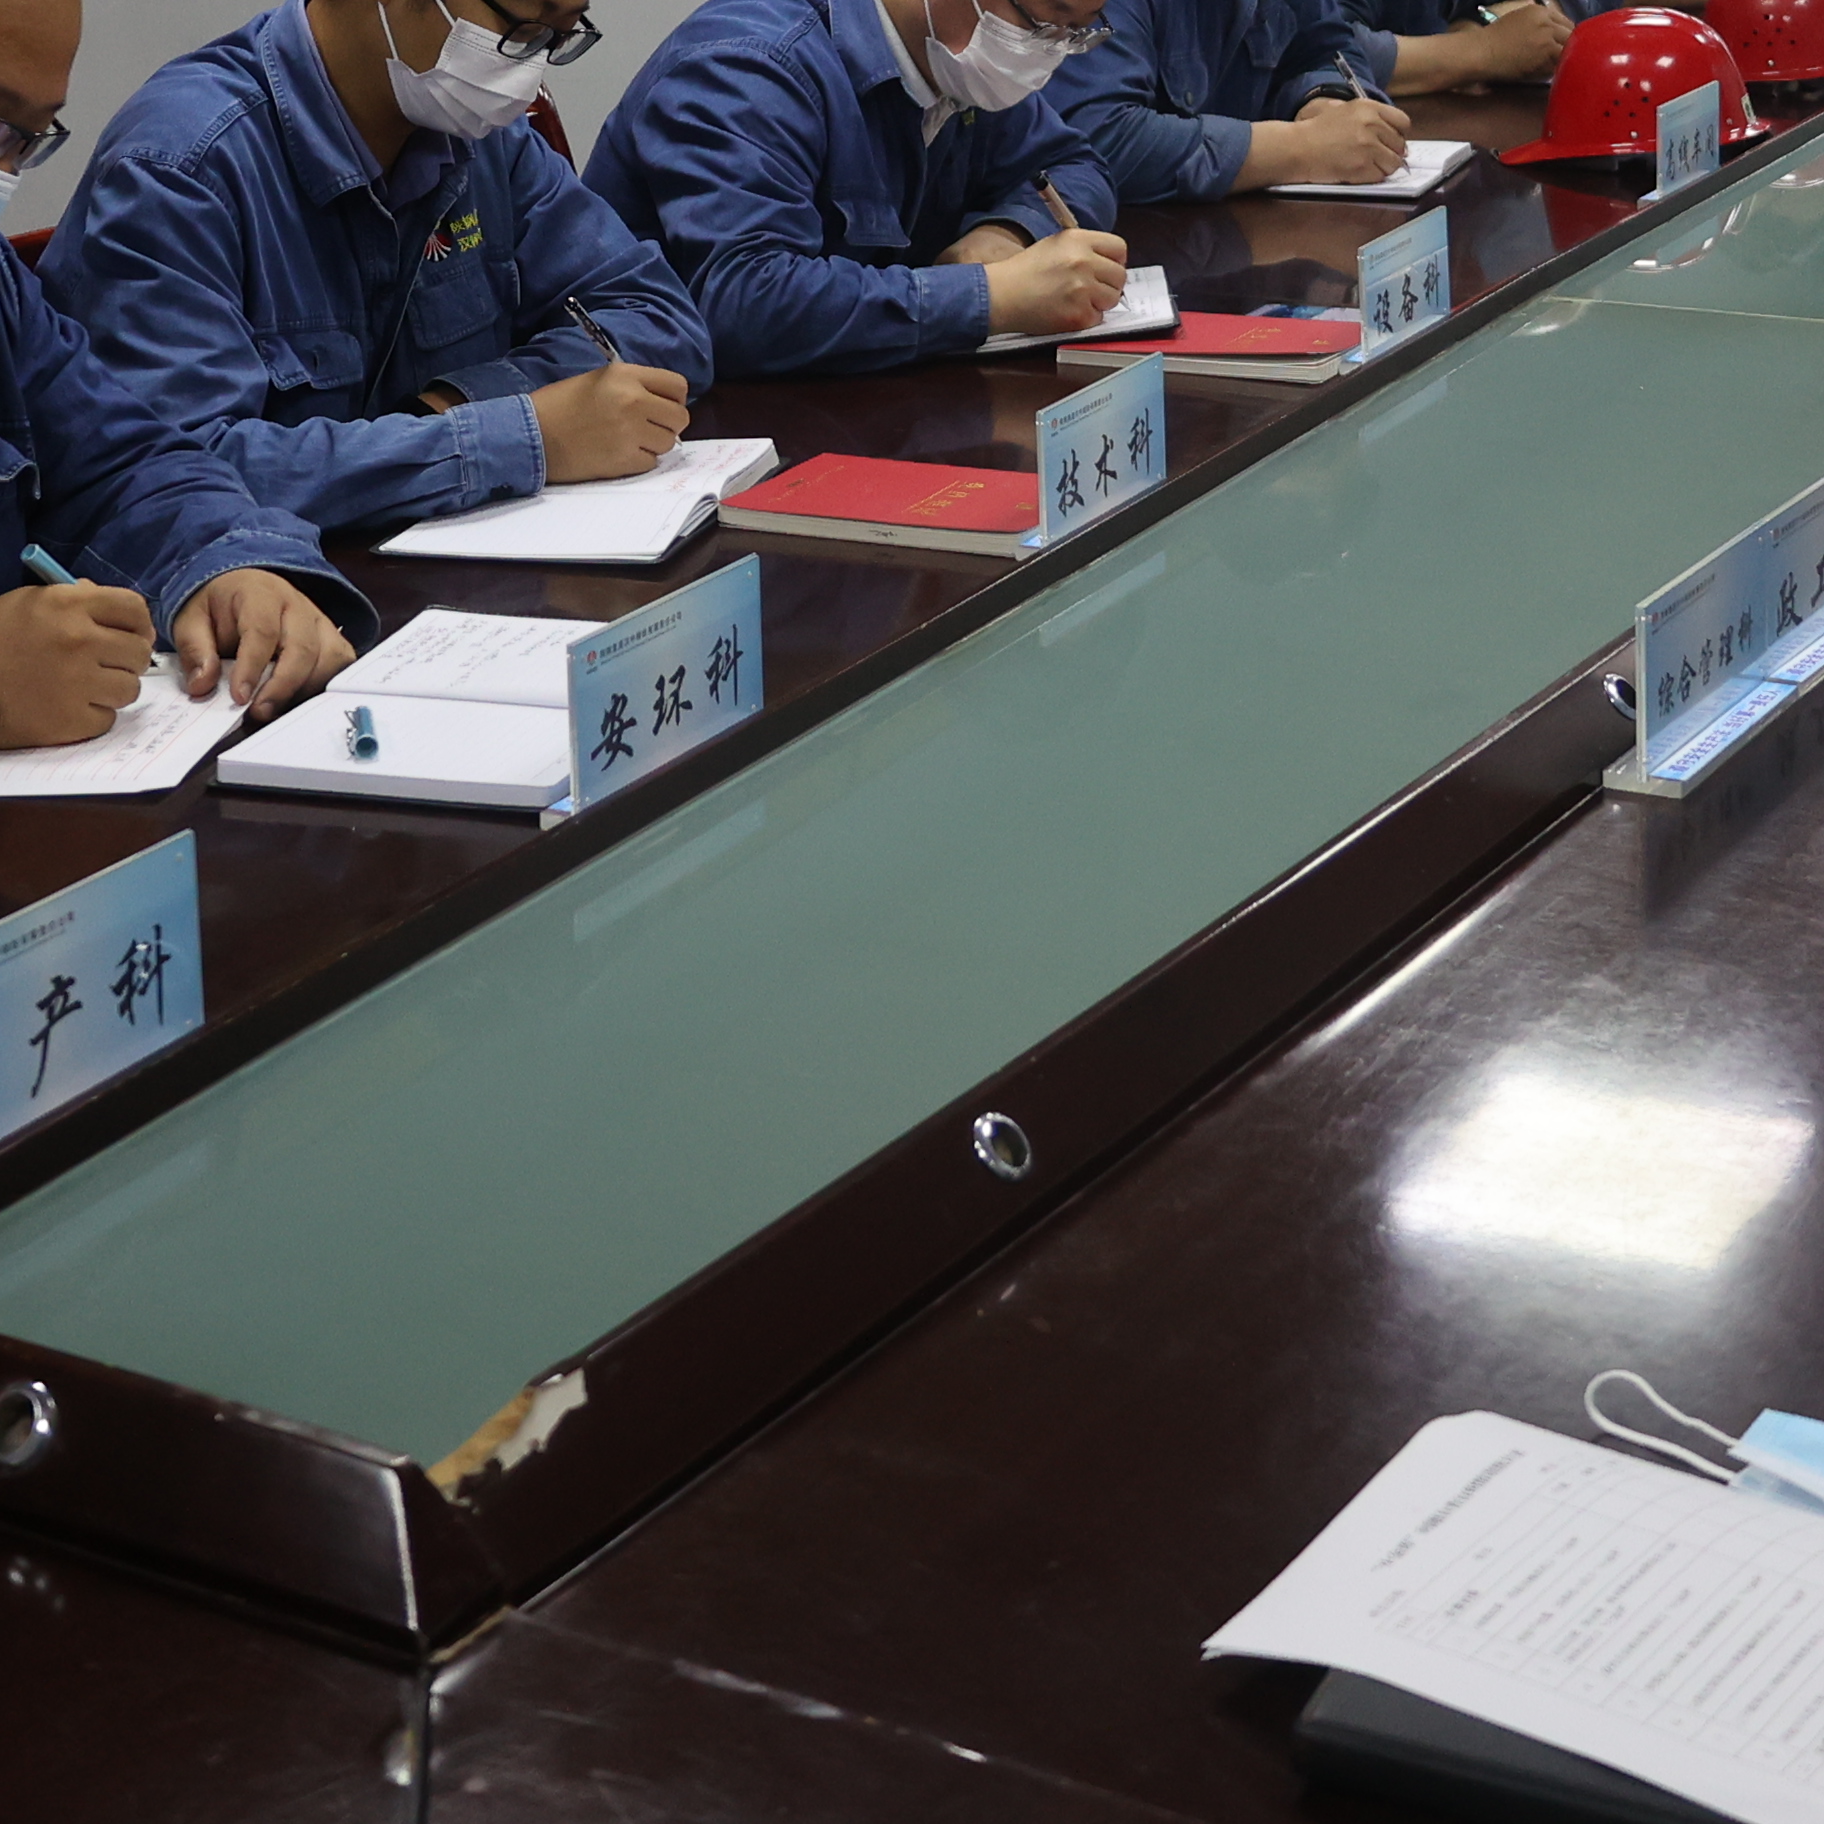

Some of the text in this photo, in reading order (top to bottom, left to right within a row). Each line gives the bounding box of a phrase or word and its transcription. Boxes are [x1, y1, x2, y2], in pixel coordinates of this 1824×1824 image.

[1372, 253, 1440, 337] 设备科
[1055, 407, 1154, 518] 技术科
[590, 623, 744, 772] 安环科
[1658, 605, 1752, 718] 综合管理科
